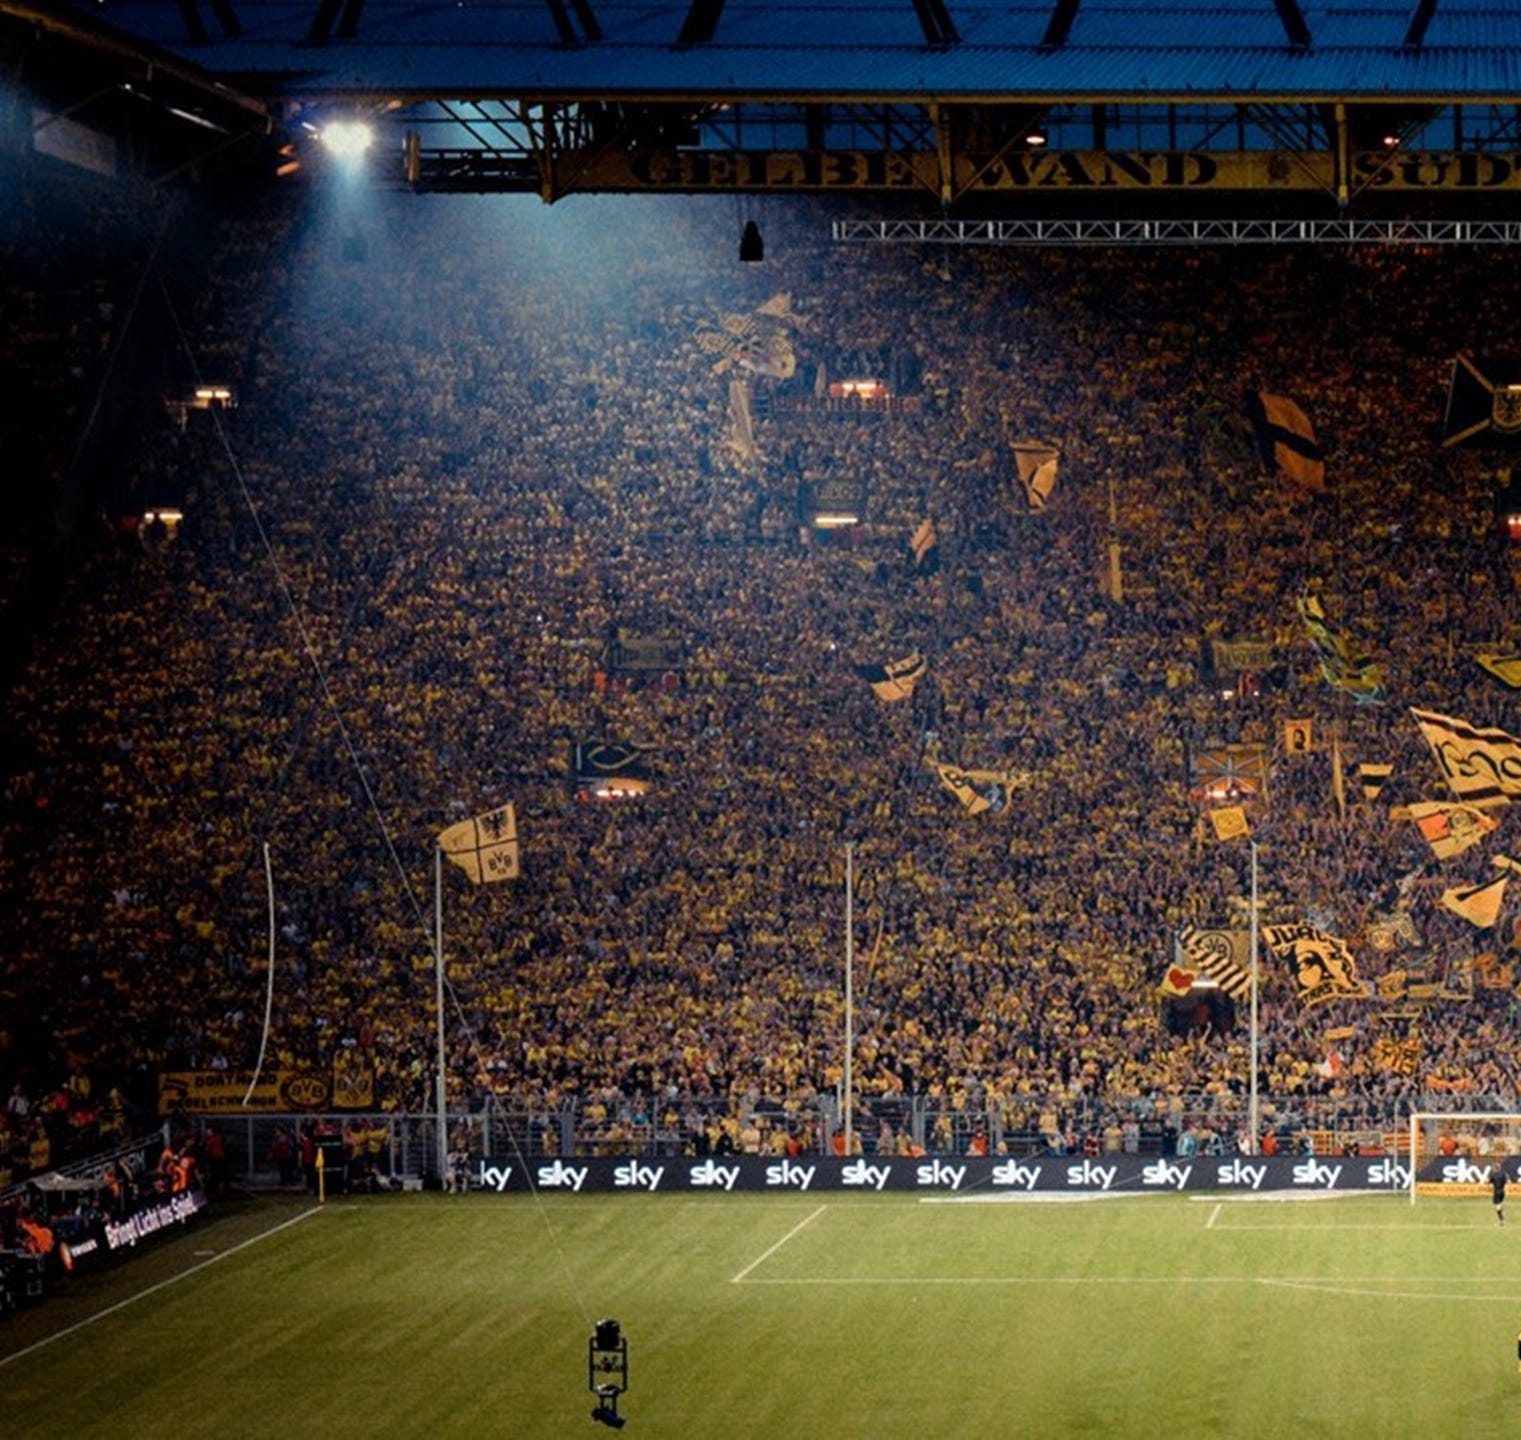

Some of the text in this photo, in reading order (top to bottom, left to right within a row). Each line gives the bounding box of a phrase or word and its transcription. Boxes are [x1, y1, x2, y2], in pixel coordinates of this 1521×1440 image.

[630, 153, 916, 185] GELBE
[967, 153, 1217, 184] WAND
[481, 1161, 512, 1190] ky
[539, 1159, 588, 1190] sky
[615, 1159, 664, 1190] sky
[691, 1159, 740, 1190] sky
[766, 1159, 815, 1190] sky
[842, 1159, 891, 1190] sky
[917, 1159, 966, 1190] sky
[992, 1159, 1041, 1190] sky
[1068, 1159, 1117, 1190] sky
[1143, 1159, 1192, 1190] sky
[1218, 1159, 1267, 1190] sky
[1293, 1159, 1342, 1190] sky
[1368, 1159, 1415, 1190] sky
[1442, 1159, 1491, 1184] sky
